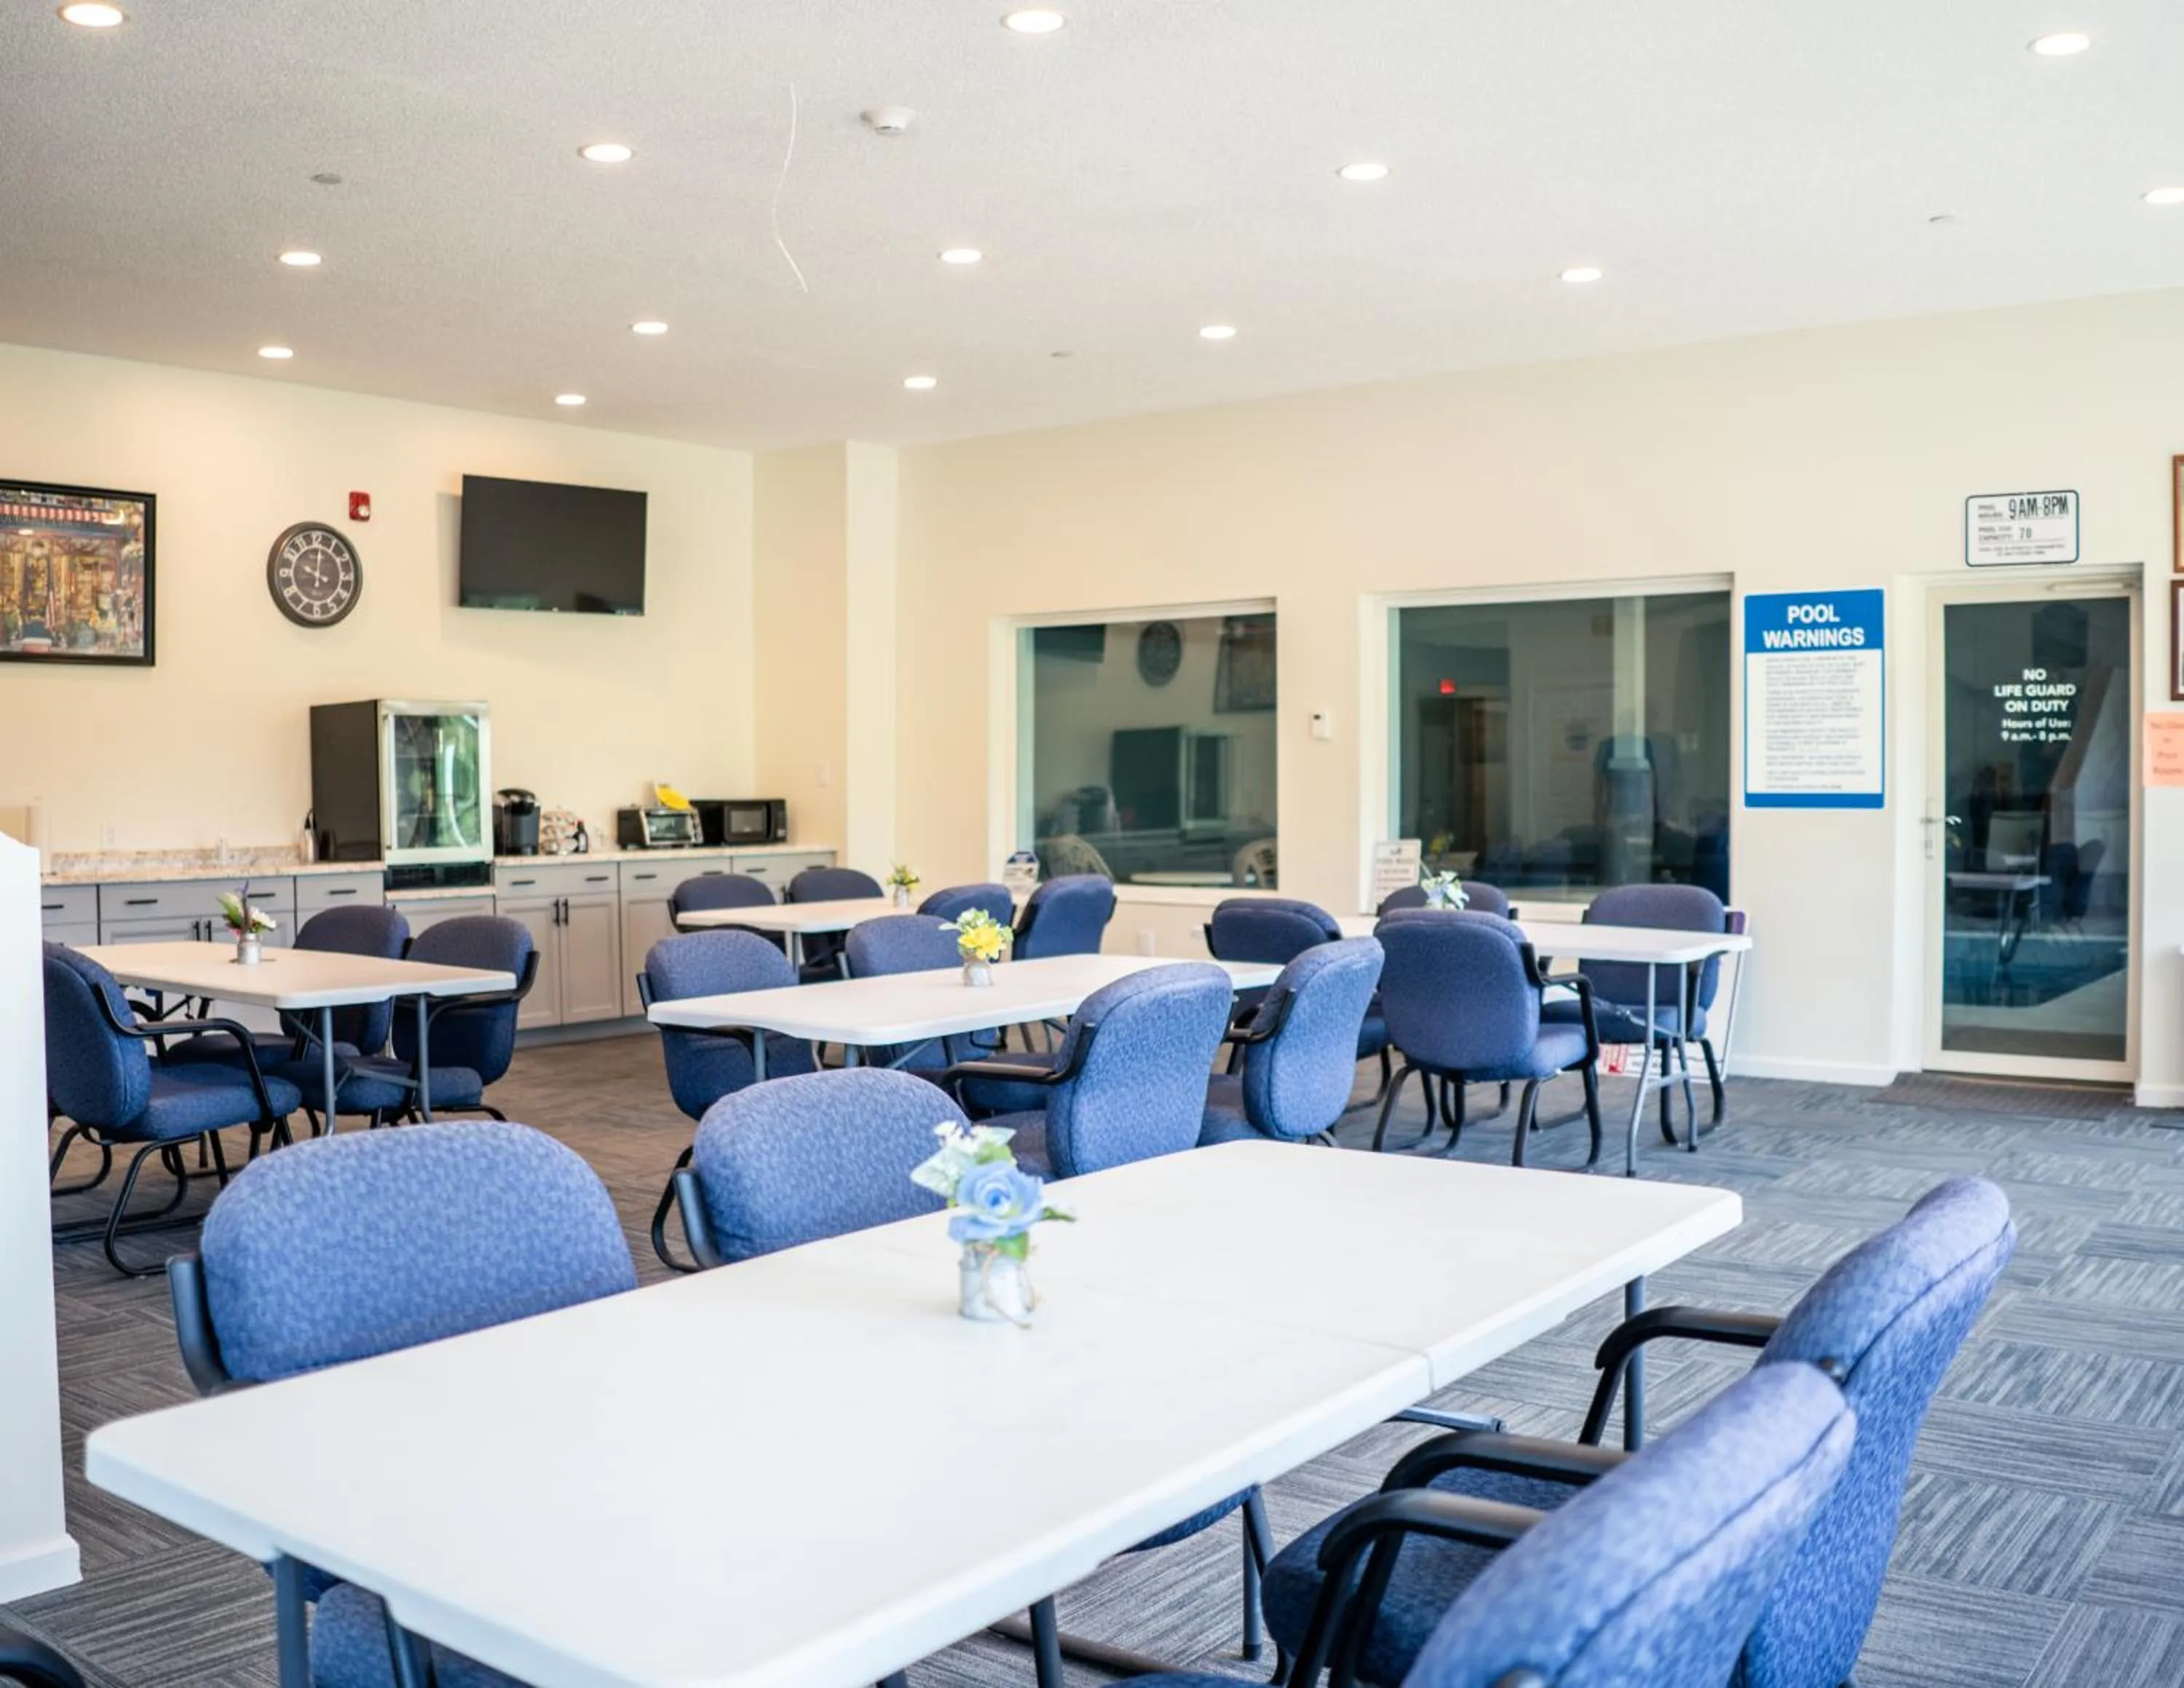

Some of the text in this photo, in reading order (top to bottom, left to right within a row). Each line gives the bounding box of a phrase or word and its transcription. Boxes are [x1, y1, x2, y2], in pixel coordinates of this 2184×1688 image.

[2008, 495, 2069, 520] 9AM-8PM
[1787, 604, 1840, 624] POOL
[1762, 627, 1864, 649] WARNINGS
[2022, 669, 2047, 681] NO
[1994, 684, 2076, 697] LIFE GUARD
[2004, 700, 2070, 713] ON DUTY
[2001, 718, 2033, 729] Hours
[2035, 717, 2046, 729] of
